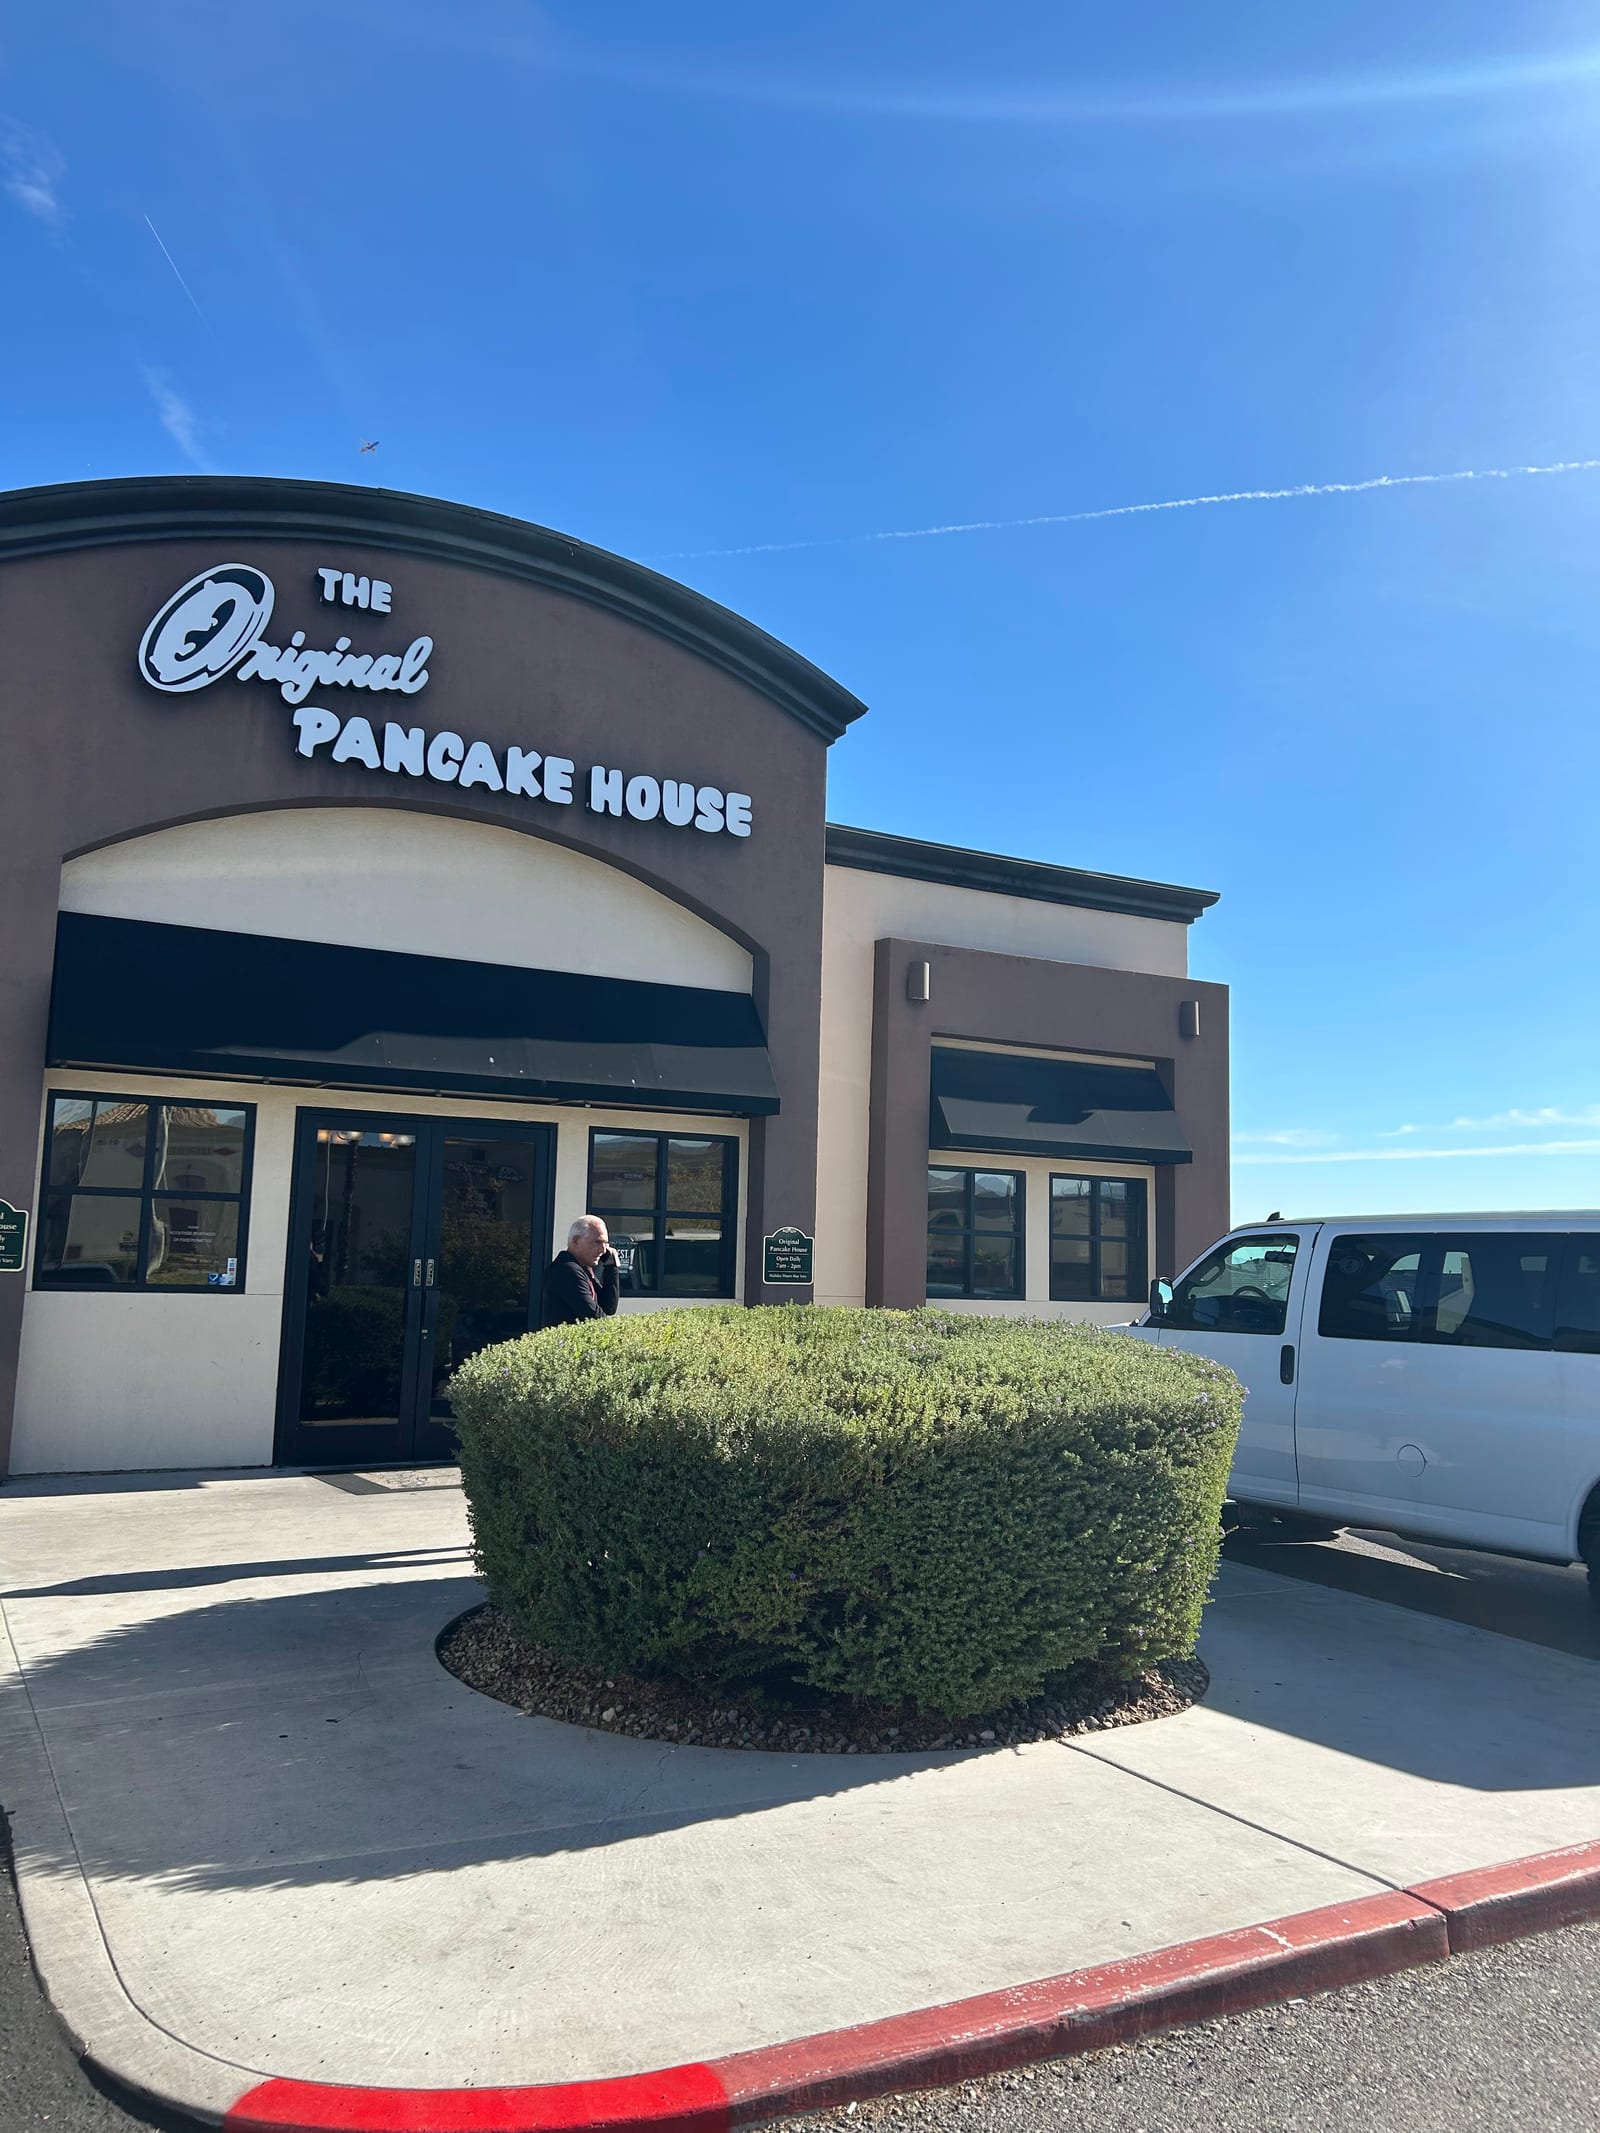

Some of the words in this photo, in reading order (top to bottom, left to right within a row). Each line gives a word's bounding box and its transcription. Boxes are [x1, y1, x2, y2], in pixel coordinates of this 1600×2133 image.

[138, 562, 434, 705] Original
[317, 567, 393, 614] THE
[292, 706, 576, 805] PANCAKE
[590, 765, 754, 839] HOUSE
